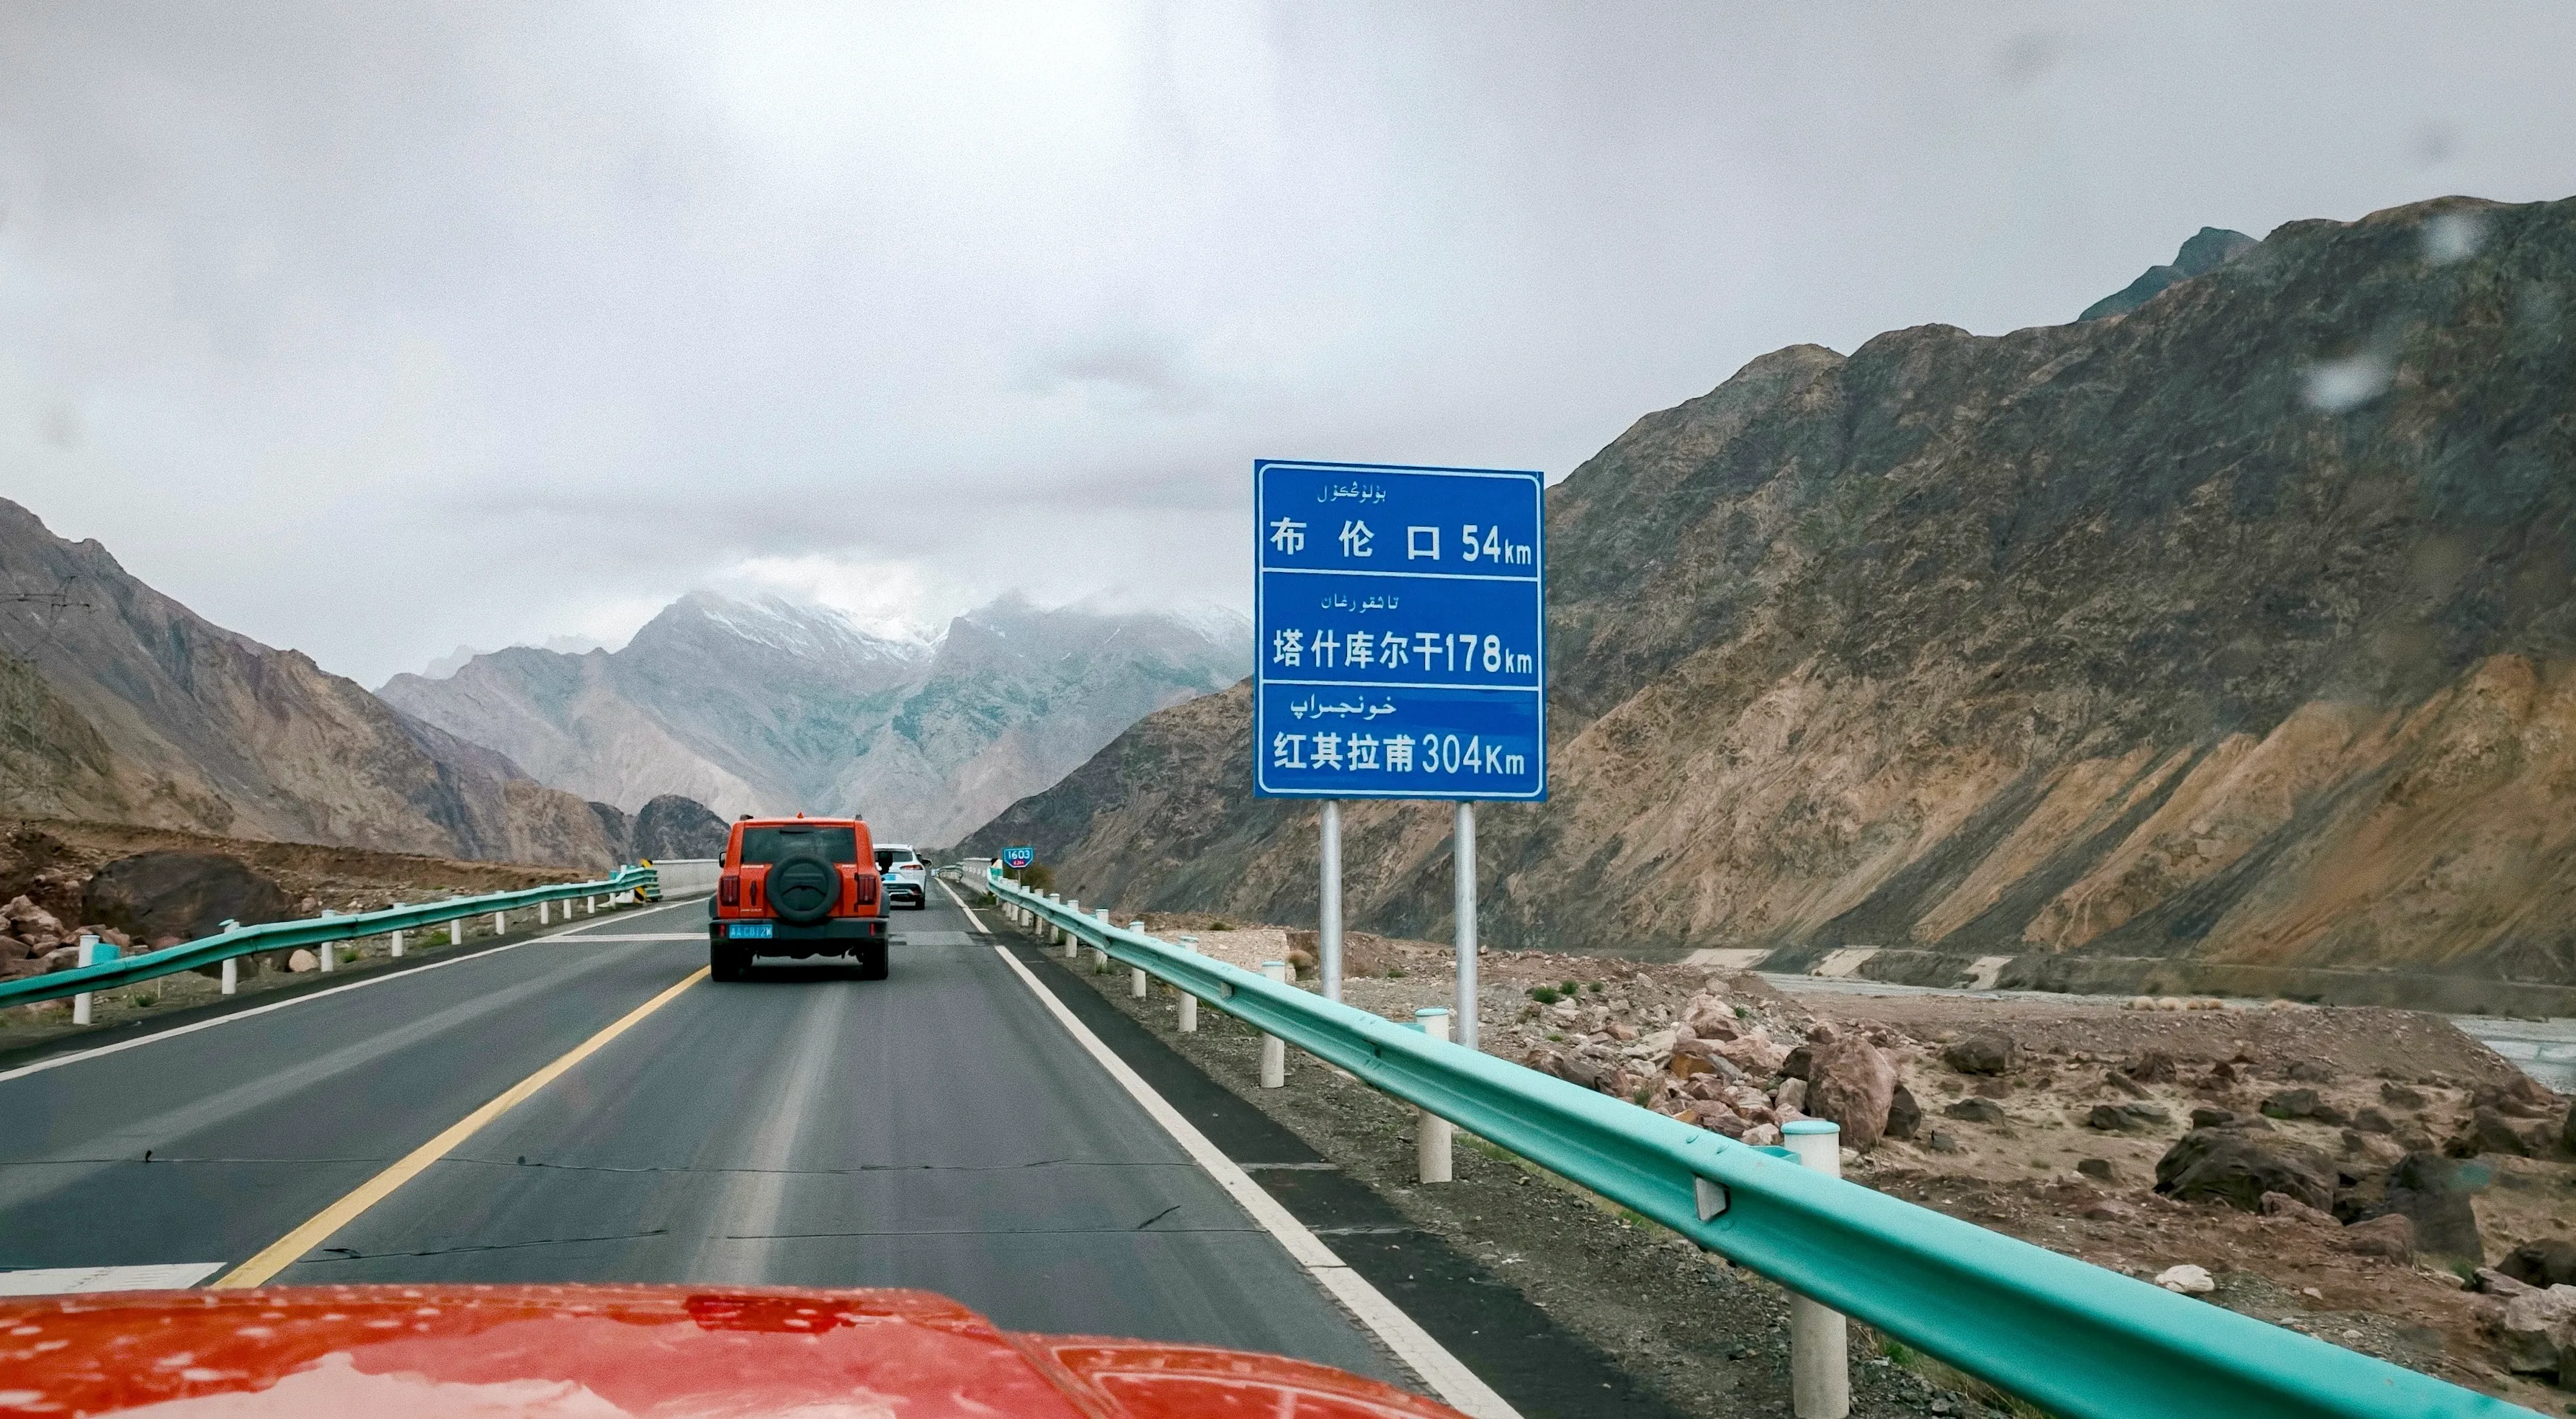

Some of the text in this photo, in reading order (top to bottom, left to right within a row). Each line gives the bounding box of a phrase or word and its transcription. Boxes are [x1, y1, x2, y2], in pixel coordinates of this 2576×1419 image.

[1270, 516, 1531, 565] 布伦口 54km
[1273, 628, 1532, 673] 塔什库尔干 178km
[1274, 731, 1416, 772] 红其拉甫
[1009, 850, 1030, 859] 1603
